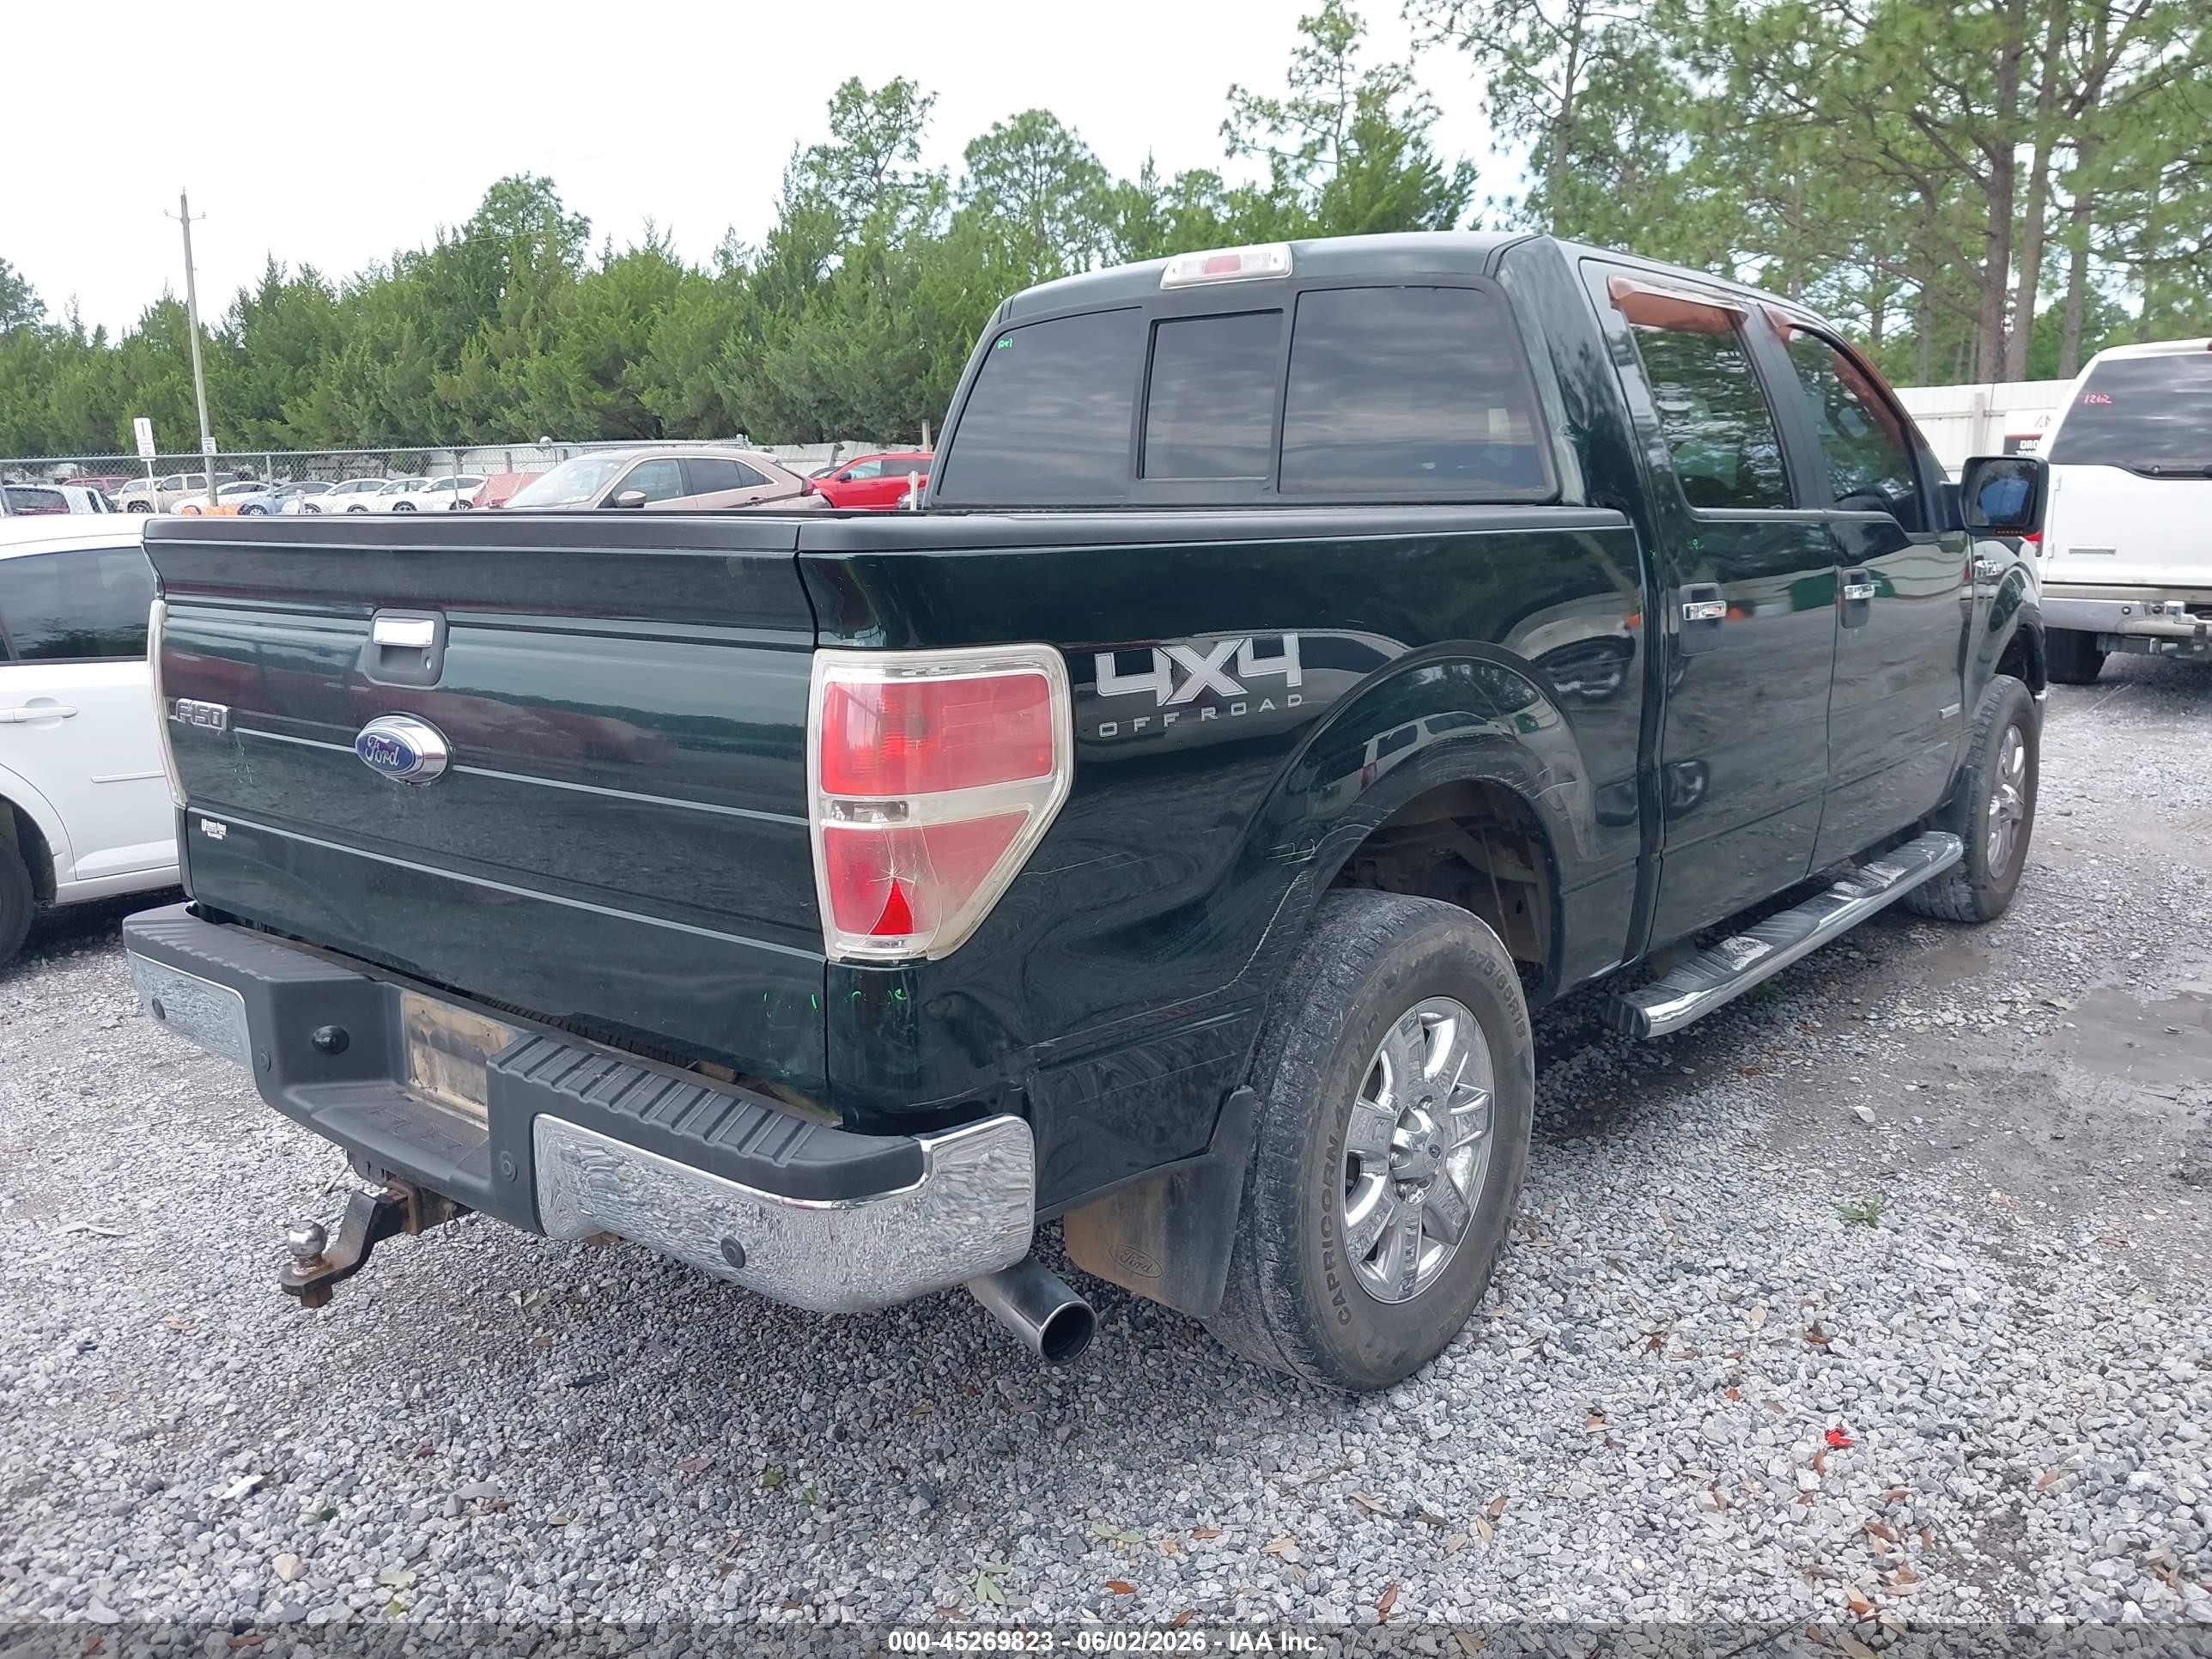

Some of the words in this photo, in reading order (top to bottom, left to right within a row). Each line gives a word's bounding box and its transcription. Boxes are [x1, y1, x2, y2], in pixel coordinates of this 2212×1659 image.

[2019, 440, 2039, 449] DRO
[1094, 632, 1303, 707] 4X4
[1097, 711, 1180, 738] OFF
[1200, 693, 1304, 722] ROAD
[364, 734, 401, 766] Ford
[1320, 1132, 1352, 1326] CAPRICORN
[1119, 1249, 1153, 1273] Ford
